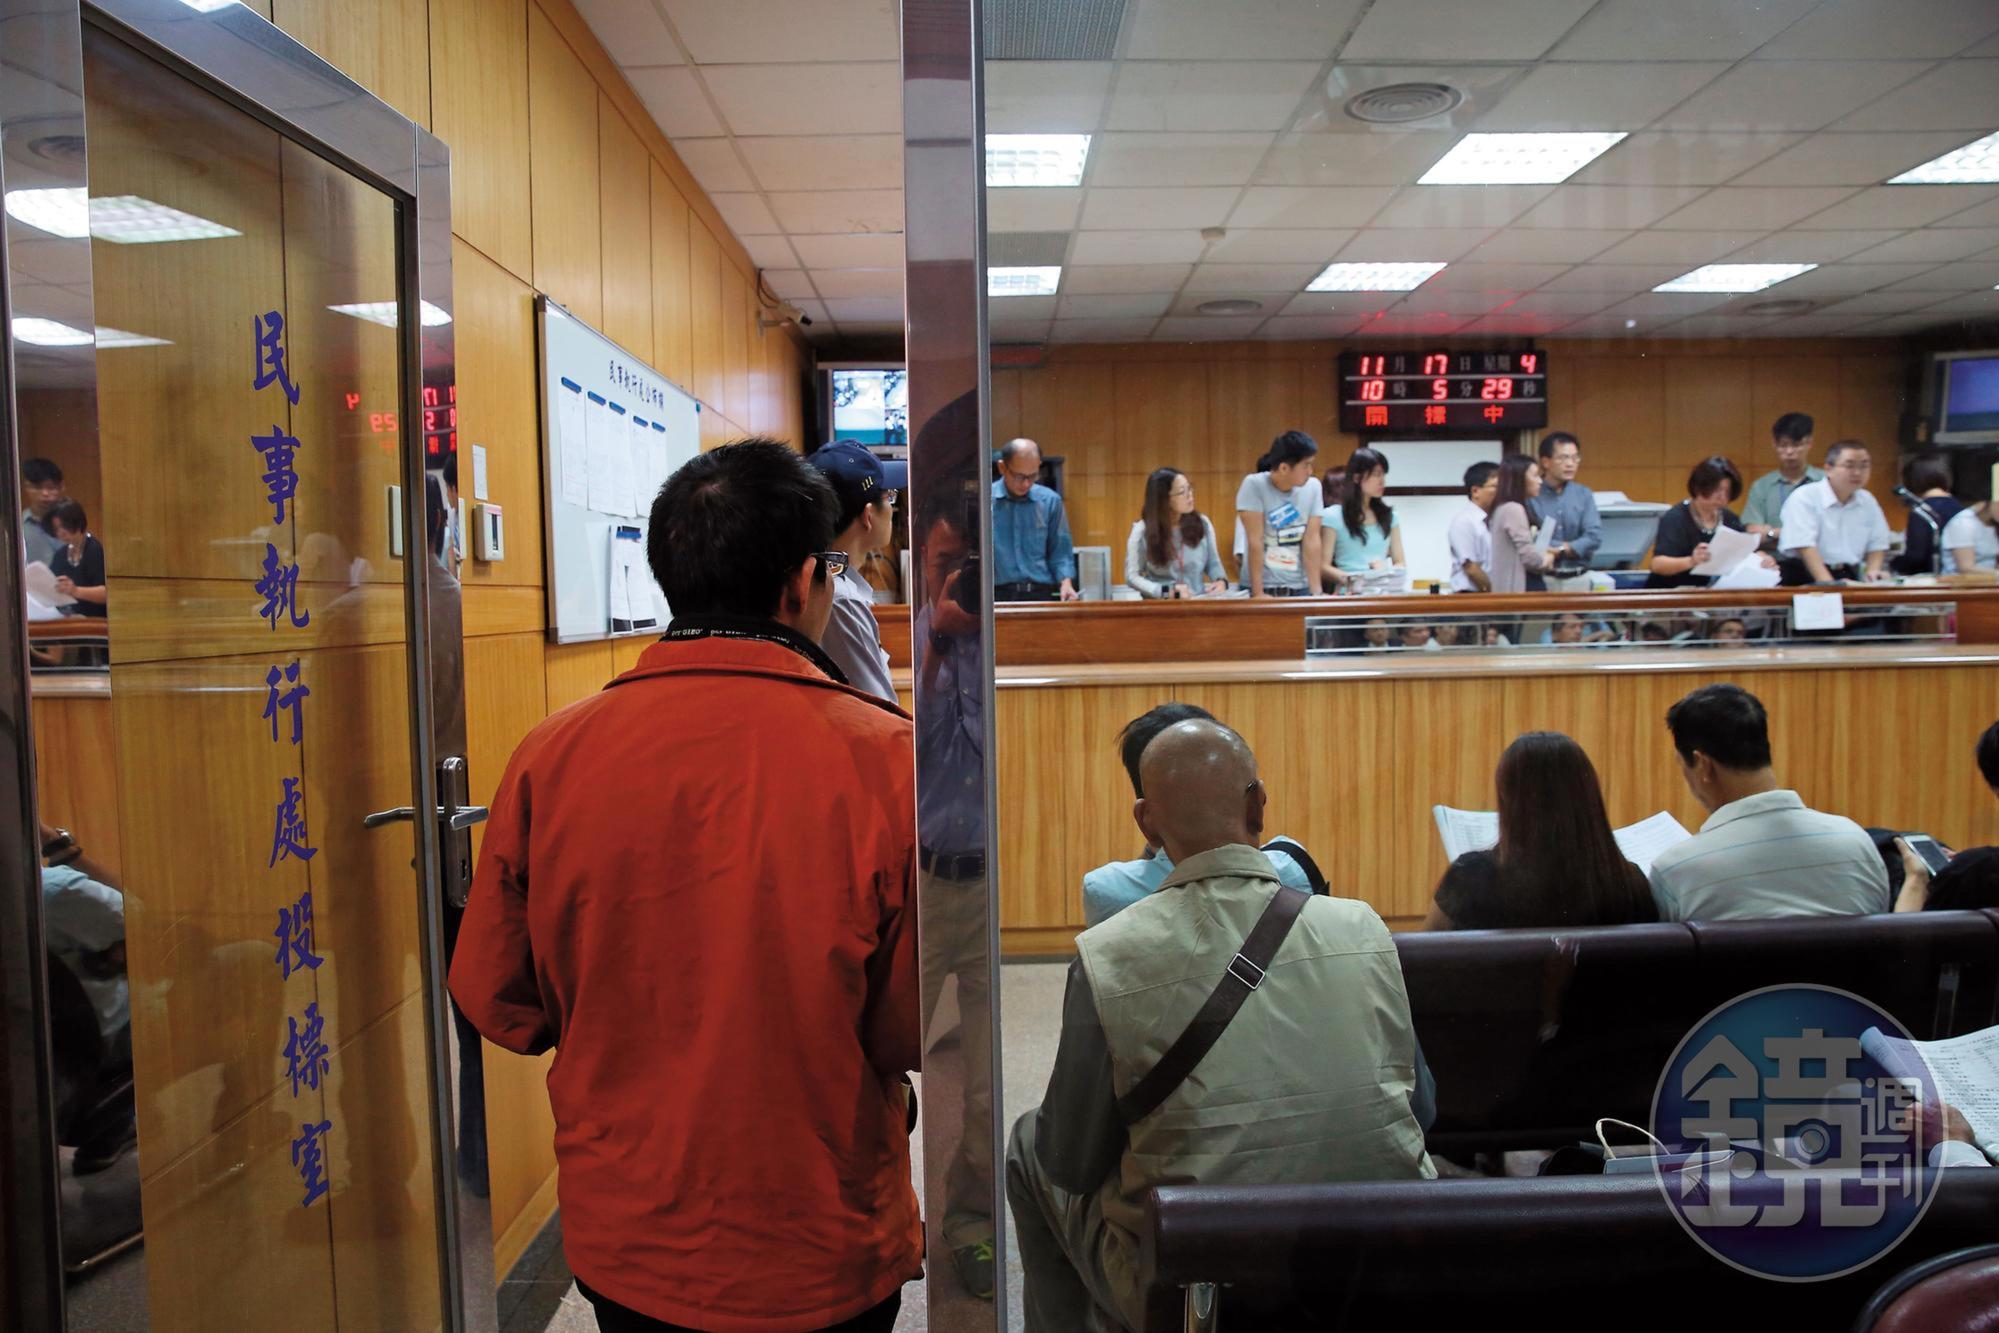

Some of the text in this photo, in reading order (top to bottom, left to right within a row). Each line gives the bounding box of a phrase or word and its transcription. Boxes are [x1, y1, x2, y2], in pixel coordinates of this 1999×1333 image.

[1360, 356, 1385, 376] 11
[1424, 354, 1448, 375] 17
[1520, 354, 1537, 374] 4
[1361, 380, 1385, 401] 10
[1432, 379, 1449, 400] 5
[1481, 379, 1513, 400] 29
[252, 311, 331, 1207] 民事執行處投標室
